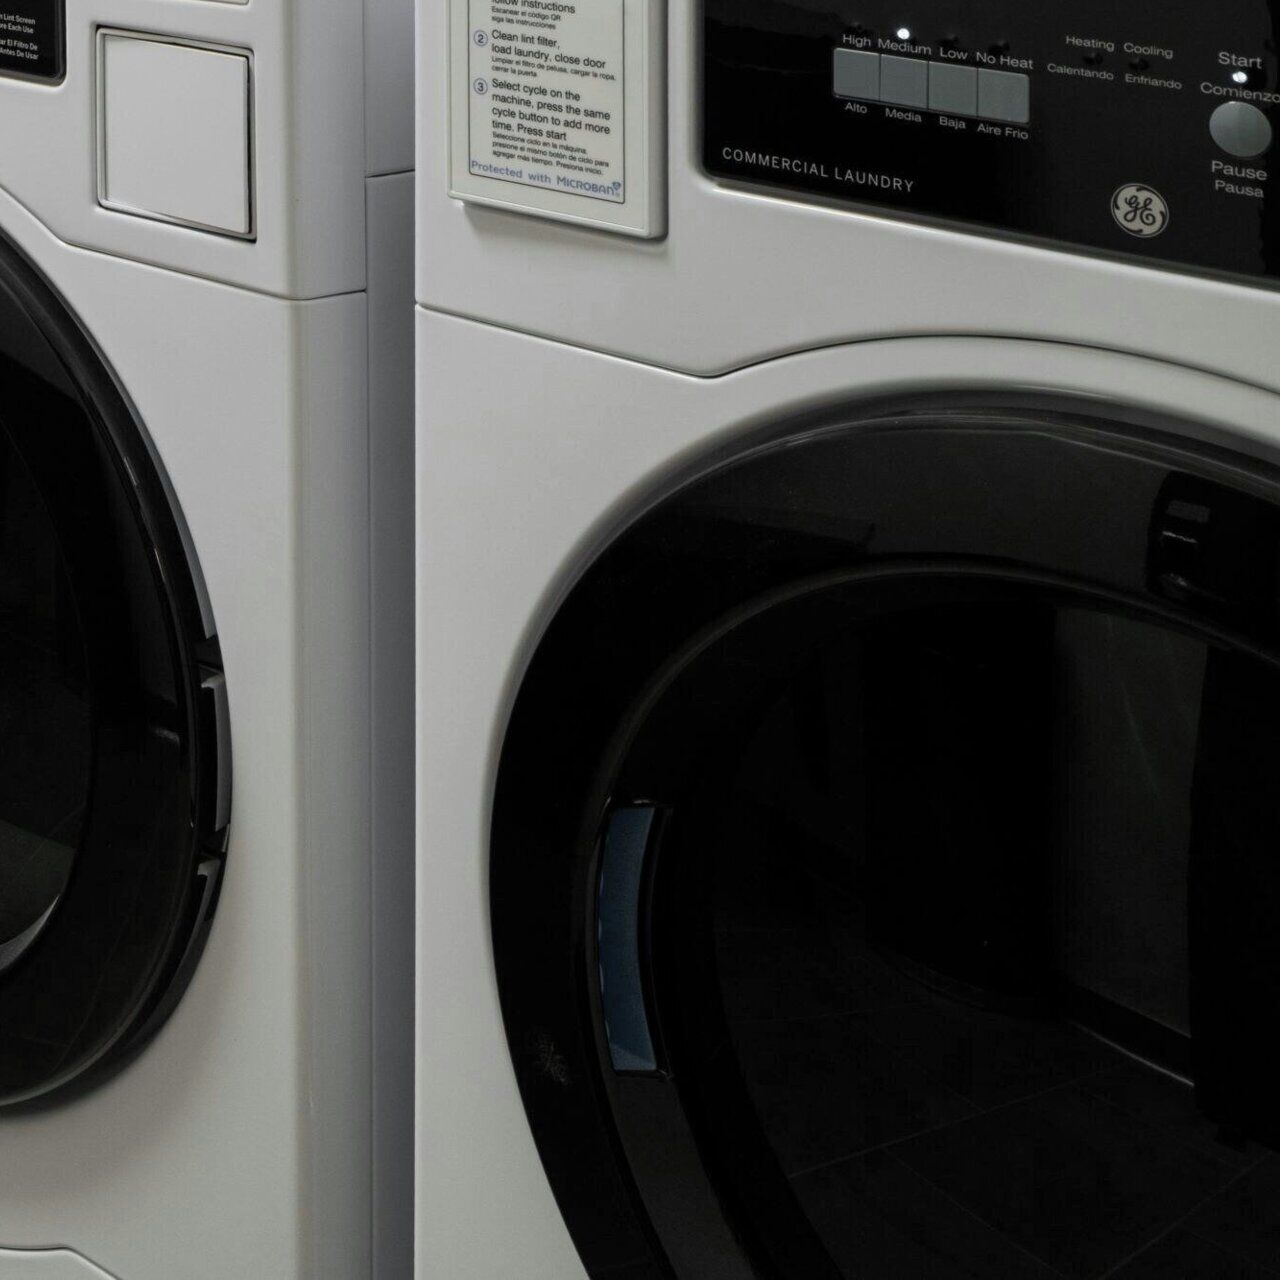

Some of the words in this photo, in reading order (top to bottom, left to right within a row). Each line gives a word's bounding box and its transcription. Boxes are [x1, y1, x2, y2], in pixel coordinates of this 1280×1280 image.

[4, 14, 14, 22] Lint
[16, 15, 36, 24] Screen
[8, 23, 22, 32] Each
[516, 18, 556, 30] instrucciones
[14, 40, 28, 49] Filtro
[492, 29, 519, 42] Clean
[521, 34, 535, 44] lint
[537, 36, 560, 50] filter,
[1065, 35, 1115, 52] Heating
[1123, 42, 1174, 60] Cooling
[0, 48, 16, 56] Antes
[25, 52, 38, 60] Usar
[492, 43, 512, 55] load
[514, 46, 552, 62] laundry,
[554, 53, 580, 66] close
[583, 57, 606, 69] door
[842, 32, 872, 48] High
[877, 37, 933, 56] Medium
[939, 46, 968, 62] Low
[976, 50, 996, 65] No
[999, 54, 1034, 70] Heat
[1218, 51, 1262, 70] Start
[1046, 62, 1114, 81] Calentando
[1124, 73, 1182, 90] Enfriando
[492, 78, 521, 92] Select
[522, 84, 548, 97] cycle
[550, 90, 563, 99] on
[565, 90, 580, 102] the
[1200, 82, 1280, 103] Comienzo
[492, 93, 534, 109] machine,
[536, 101, 564, 113] press
[566, 104, 581, 116] the
[584, 108, 611, 120] same
[492, 107, 516, 119] cycle
[518, 110, 549, 124] button
[551, 116, 561, 126] to
[563, 118, 582, 130] add
[584, 122, 611, 134] more
[492, 120, 514, 132] time.
[517, 123, 544, 137] Press
[546, 128, 567, 140] start
[844, 101, 868, 114] Alto
[884, 106, 922, 122] Media
[938, 116, 966, 130] Baja
[976, 122, 1002, 136] Aire
[1004, 126, 1030, 140] Frio
[471, 160, 523, 178] Protected
[528, 172, 552, 184] with
[722, 146, 829, 178] COMMERCIAL
[834, 167, 914, 193] LAUNDRY
[1211, 160, 1268, 181] Pause
[1214, 180, 1264, 198] Pausa
